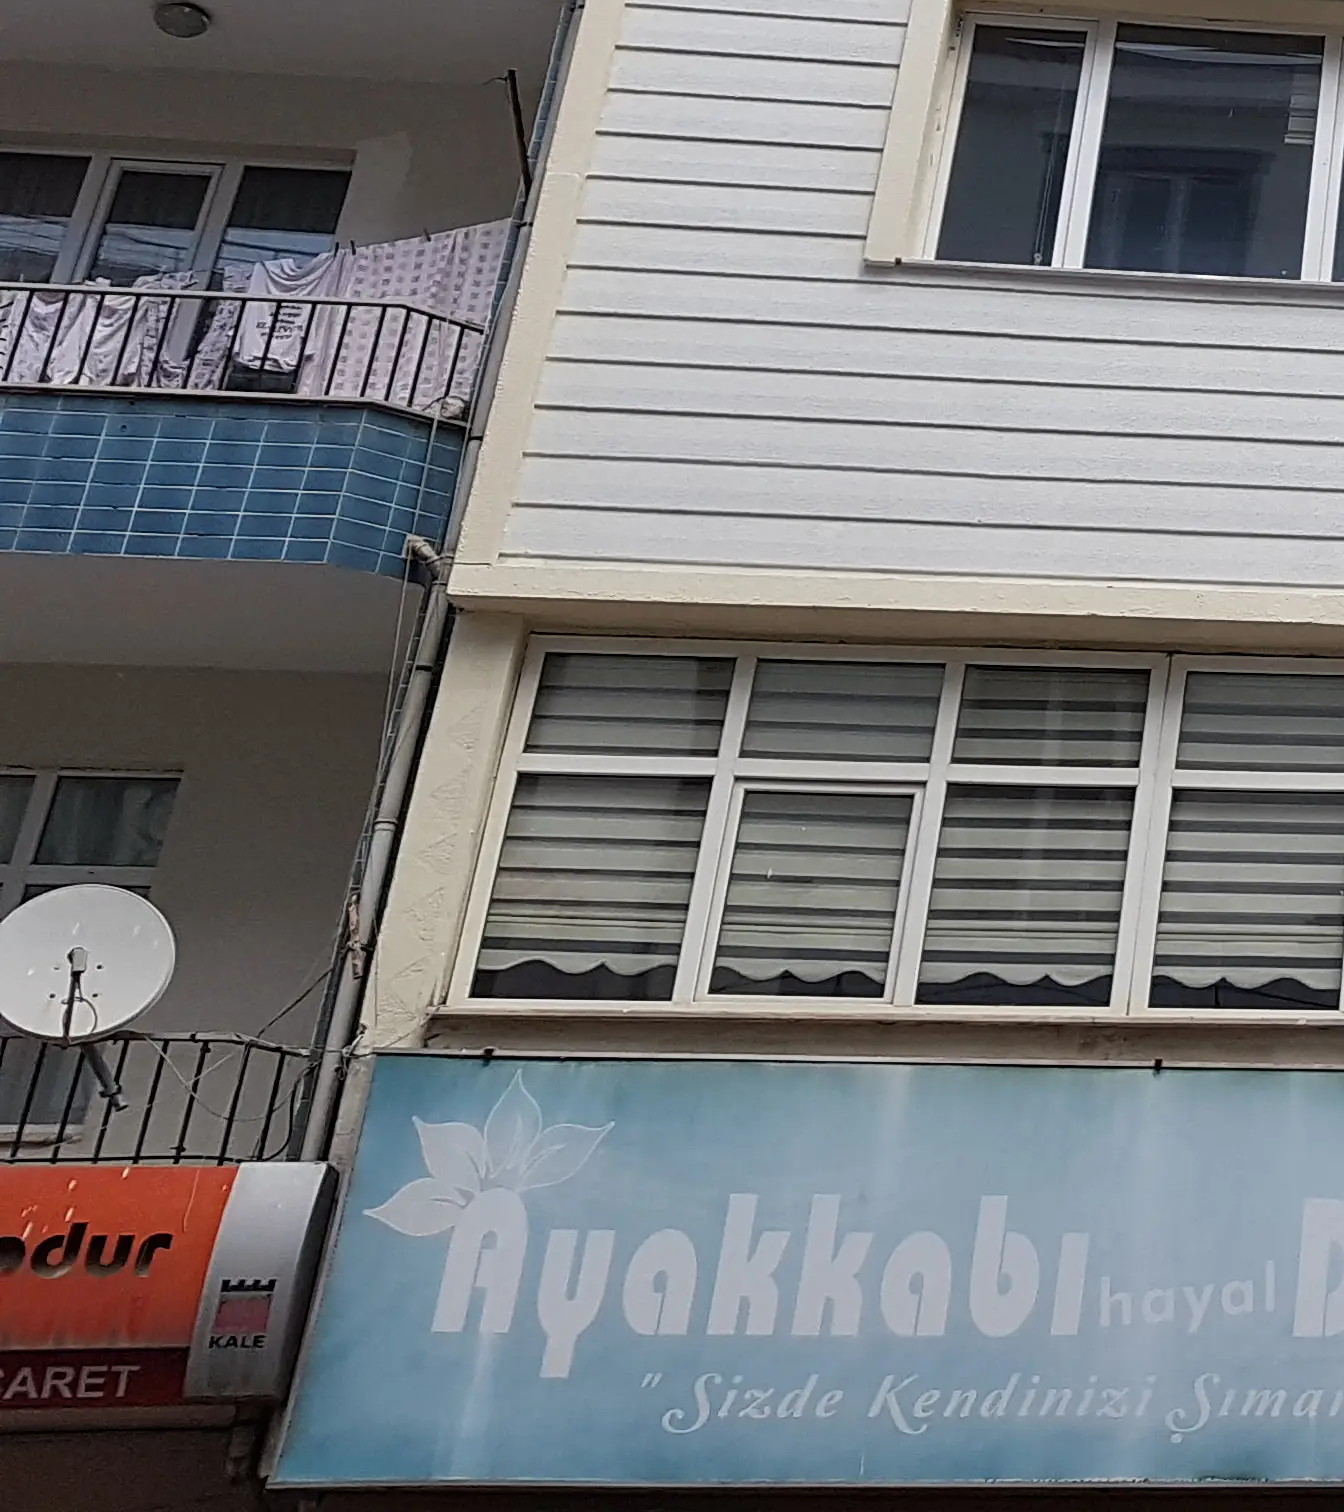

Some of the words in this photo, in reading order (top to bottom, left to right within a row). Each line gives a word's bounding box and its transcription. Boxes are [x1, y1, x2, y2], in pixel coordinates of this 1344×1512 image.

[430, 1187, 1090, 1379] Ayakkabı
[1099, 1259, 1275, 1335] hayal
[208, 1335, 267, 1349] KALE
[0, 1365, 141, 1400] ARET
[867, 1373, 1157, 1435] Kendinizi
